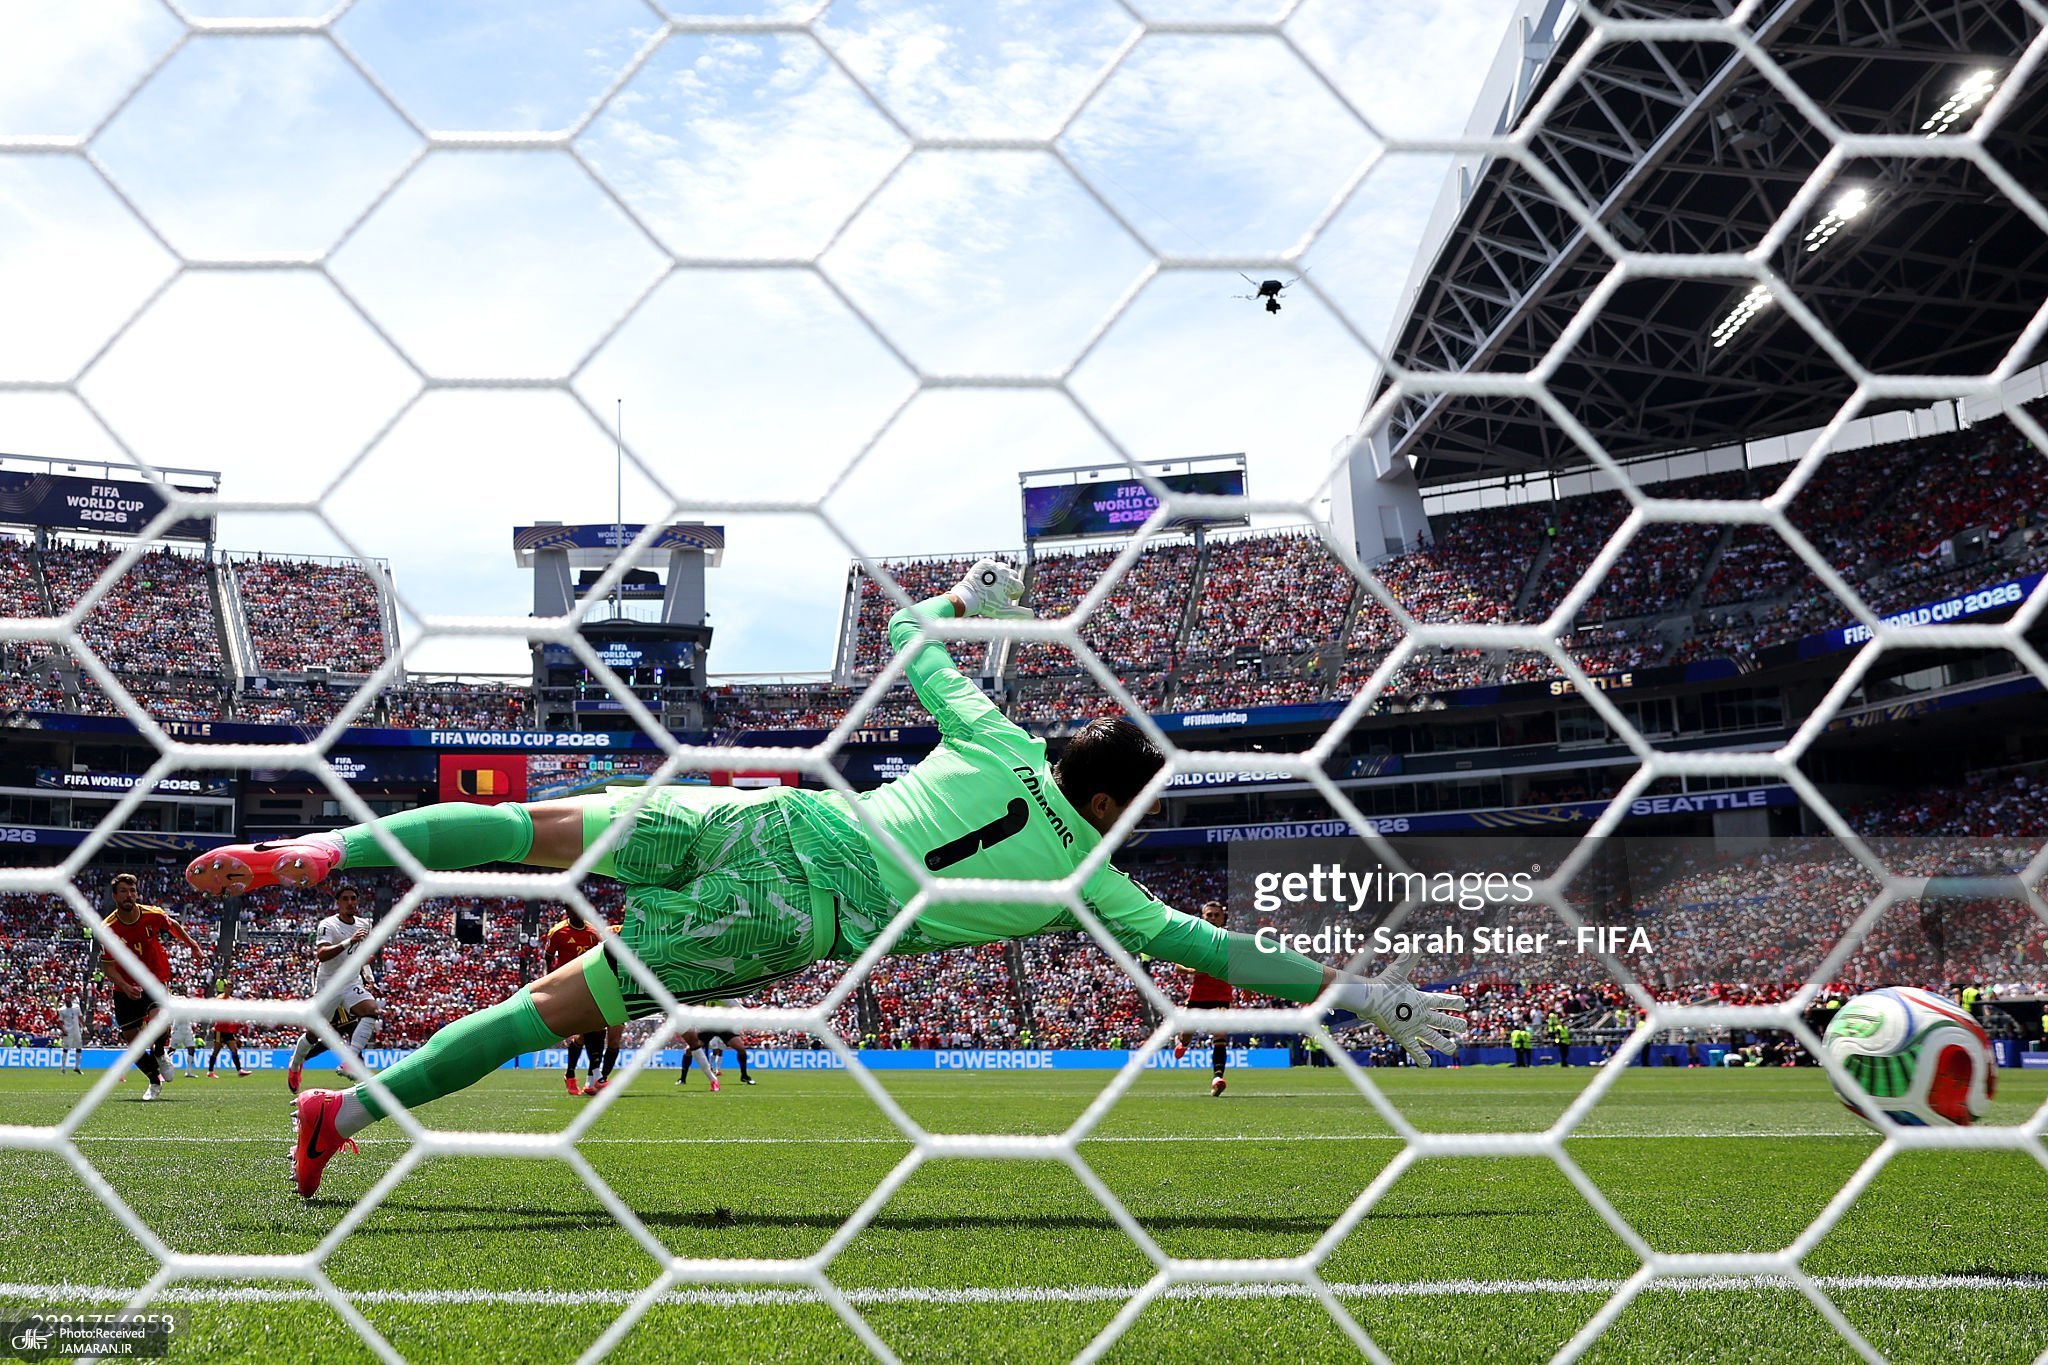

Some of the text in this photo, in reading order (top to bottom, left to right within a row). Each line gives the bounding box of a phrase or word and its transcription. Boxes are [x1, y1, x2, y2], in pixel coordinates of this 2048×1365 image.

[91, 486, 120, 498] FIFA
[1117, 486, 1146, 498] FIFA
[66, 495, 144, 512] WORLD CUP
[1093, 496, 1160, 512] WORLD CU
[80, 509, 128, 523] 2026
[1932, 601, 1963, 621] CUP
[1964, 583, 2022, 613] 2026
[1183, 712, 1248, 727] #FIFAWorldCup
[159, 723, 211, 736] ATTLE
[847, 729, 899, 743] ATTLE
[431, 732, 610, 746] FIFA WORLD CUP 2026
[335, 757, 352, 765] FIFA
[64, 774, 90, 786] FIFA
[91, 776, 133, 788] WORLD
[159, 779, 201, 791] 2026
[1205, 772, 1236, 784] CUP
[1632, 790, 1768, 816] SEATTLE
[924, 797, 1029, 872] 1
[1207, 828, 1243, 843] FIFA
[1247, 824, 1307, 841] WORLD
[1311, 822, 1345, 837] CUP
[935, 1050, 1052, 1068] POWERADE
